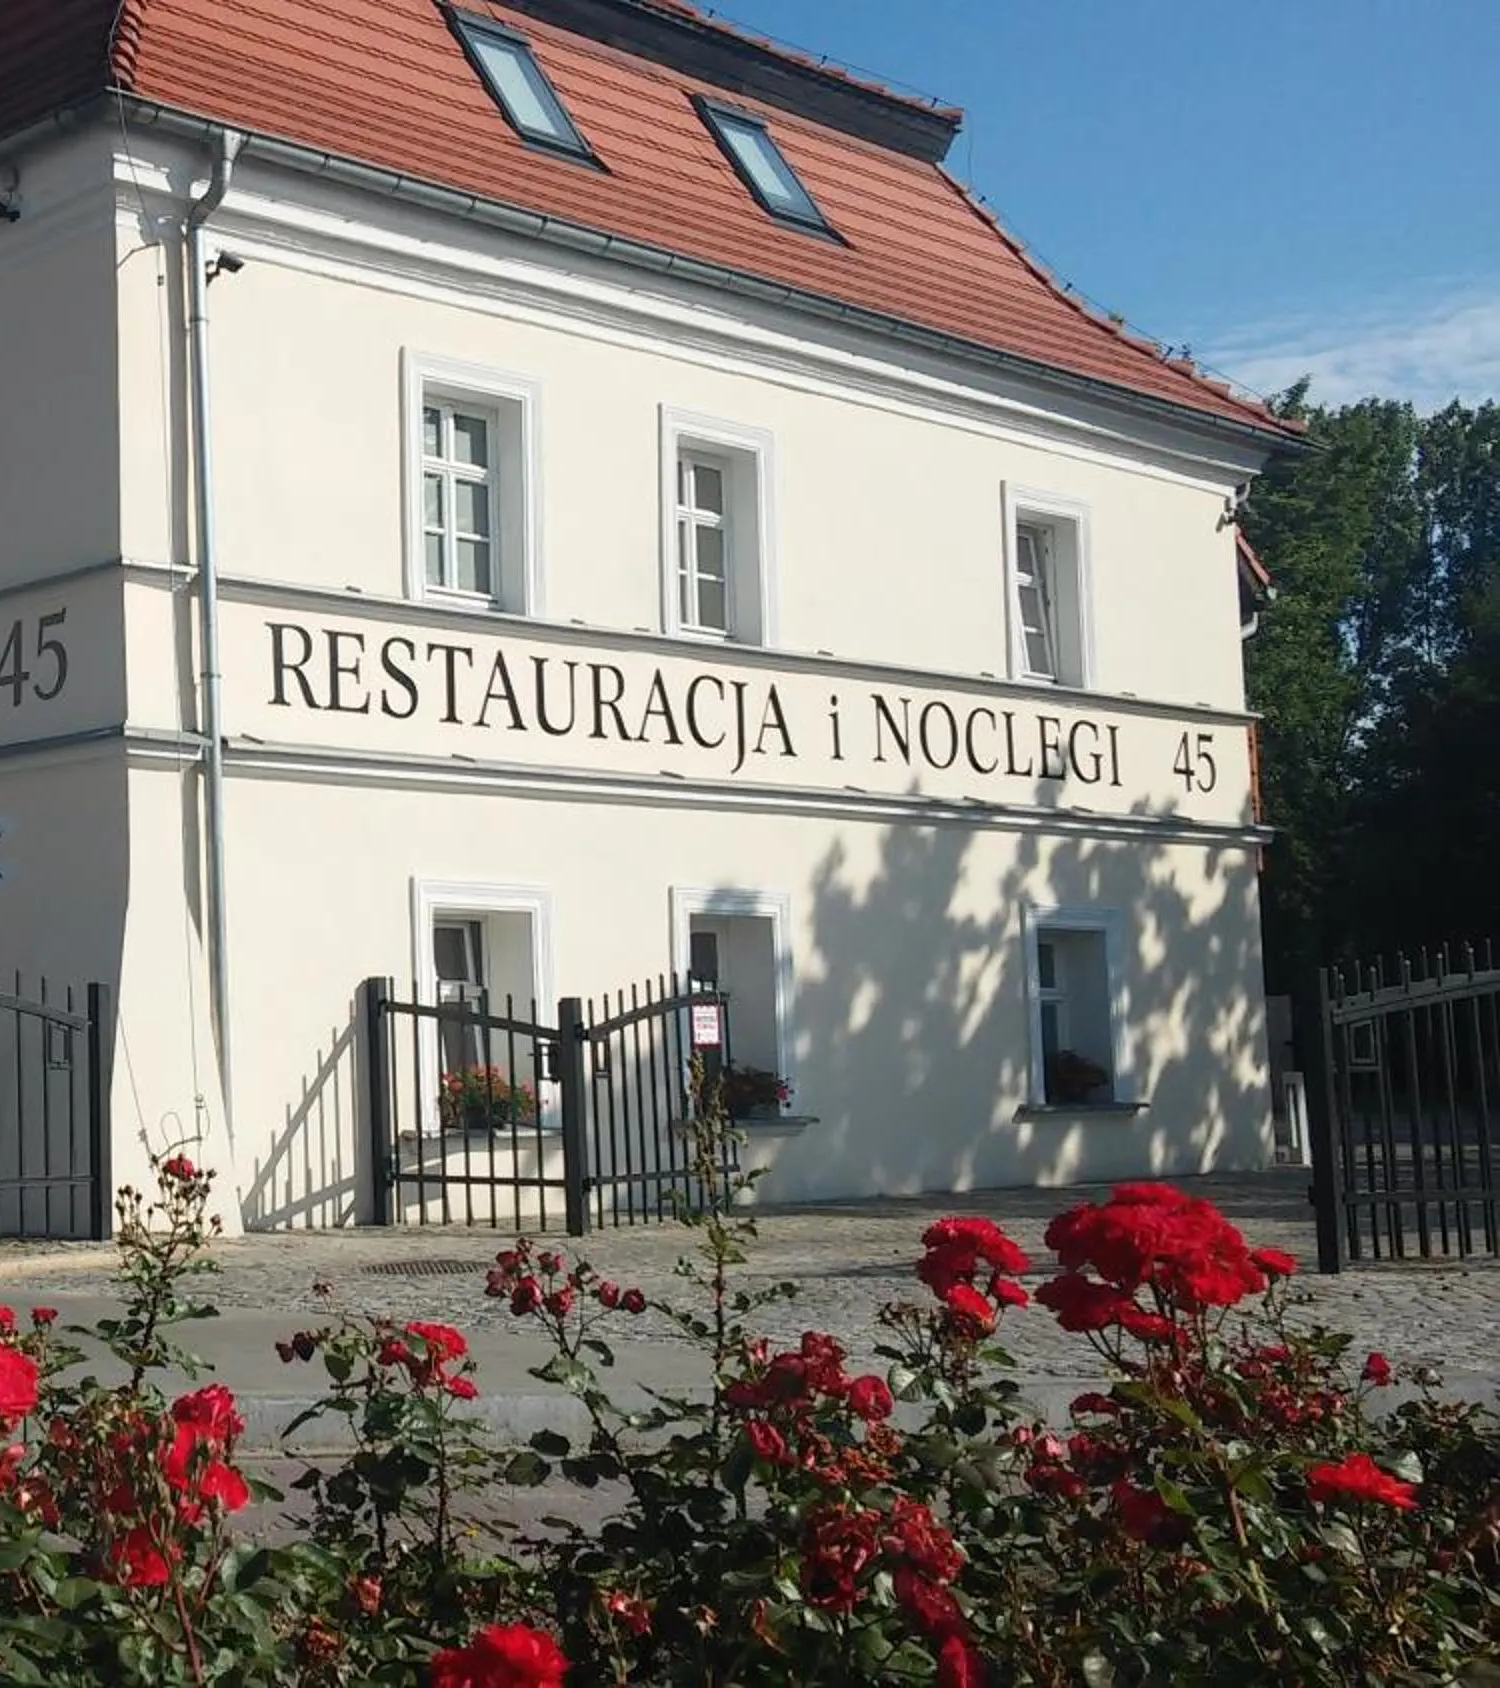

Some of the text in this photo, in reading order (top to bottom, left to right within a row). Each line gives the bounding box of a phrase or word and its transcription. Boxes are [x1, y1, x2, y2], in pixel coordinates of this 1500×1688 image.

[264, 621, 1122, 787] RESTAURACJA i NOCLEGI
[1172, 730, 1217, 792] 45
